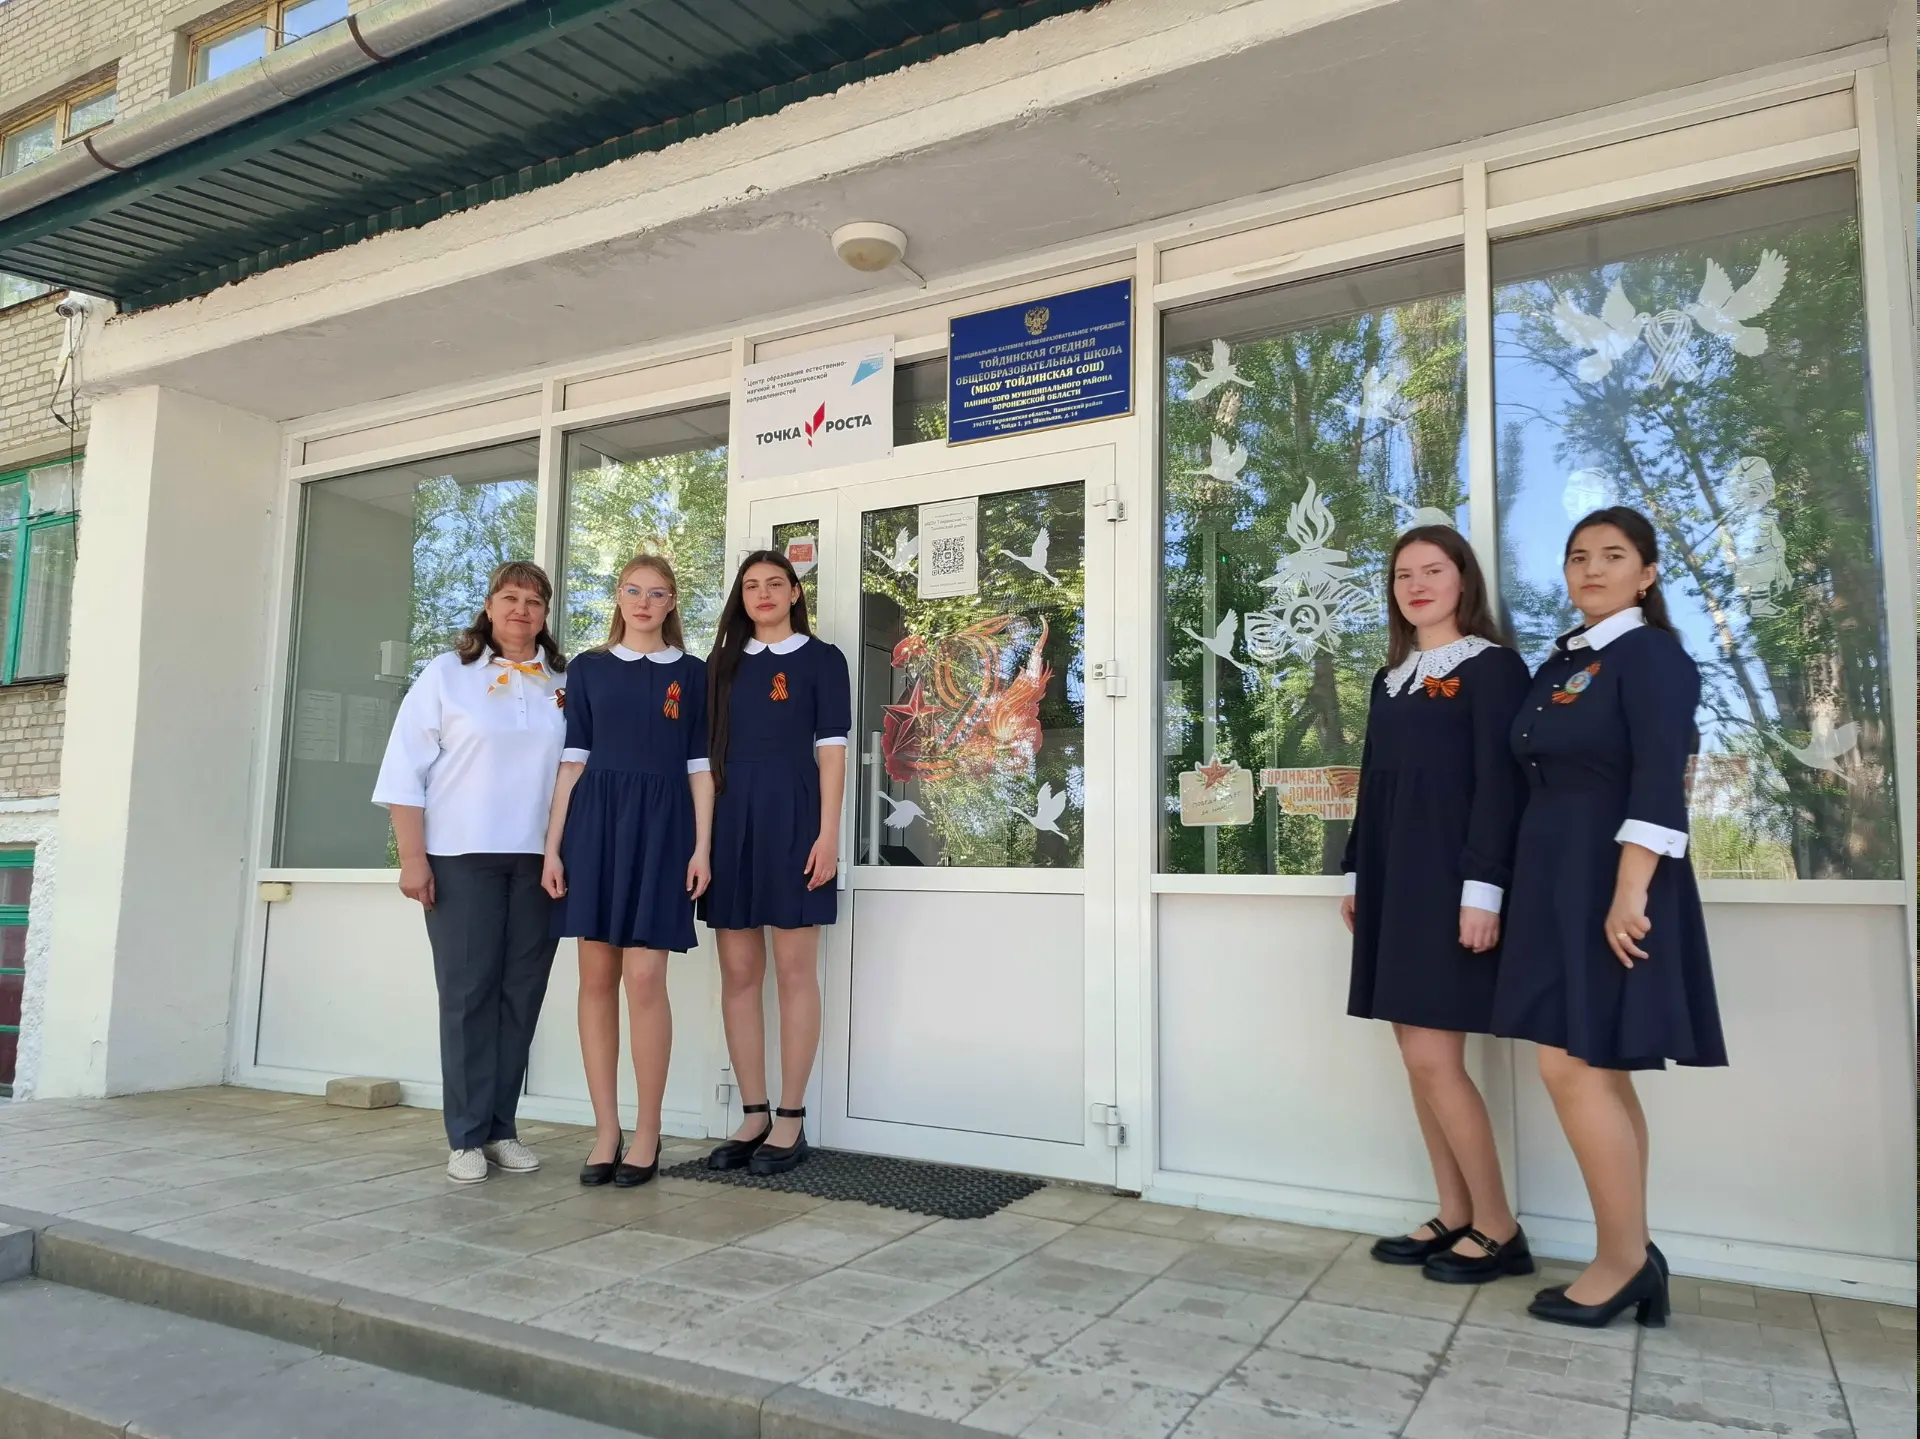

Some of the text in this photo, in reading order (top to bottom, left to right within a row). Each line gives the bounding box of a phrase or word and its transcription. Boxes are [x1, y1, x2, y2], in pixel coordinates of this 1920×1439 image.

[954, 347, 998, 361] МУНИЦИПАЛЬНОЕ
[1025, 329, 1089, 346] ОБЩЕОБРАЗОВАТЕЛЬНОЕ
[1089, 320, 1126, 333] УЧРЕЖДЕНИЕ
[979, 337, 1096, 369] ТОЙДИНСКАЯ СРЕДНЯЯ
[747, 378, 765, 388] Центр
[766, 370, 804, 383] образования
[805, 361, 848, 374] естественно-
[956, 345, 1122, 386] ОБЩЕОБРАЗОВАТЕЛЬНАЯ ШКОЛА
[971, 361, 1105, 395] (МКОУ ТОЙДИНСКАЯ СОШ)
[746, 386, 770, 396] научной
[777, 373, 828, 389] технологической
[746, 388, 797, 404] направленностей
[964, 374, 1113, 408] ПАНИНСКОГО МУНИЦИПАЛЬНОГО РАЙОНА
[992, 389, 1081, 410] ВОРОНЕЖСКОЙ ОБЛАСТИ
[1053, 403, 1085, 413] Панинский
[1085, 400, 1103, 409] район
[756, 414, 873, 446] ТОЧКА РОСТА
